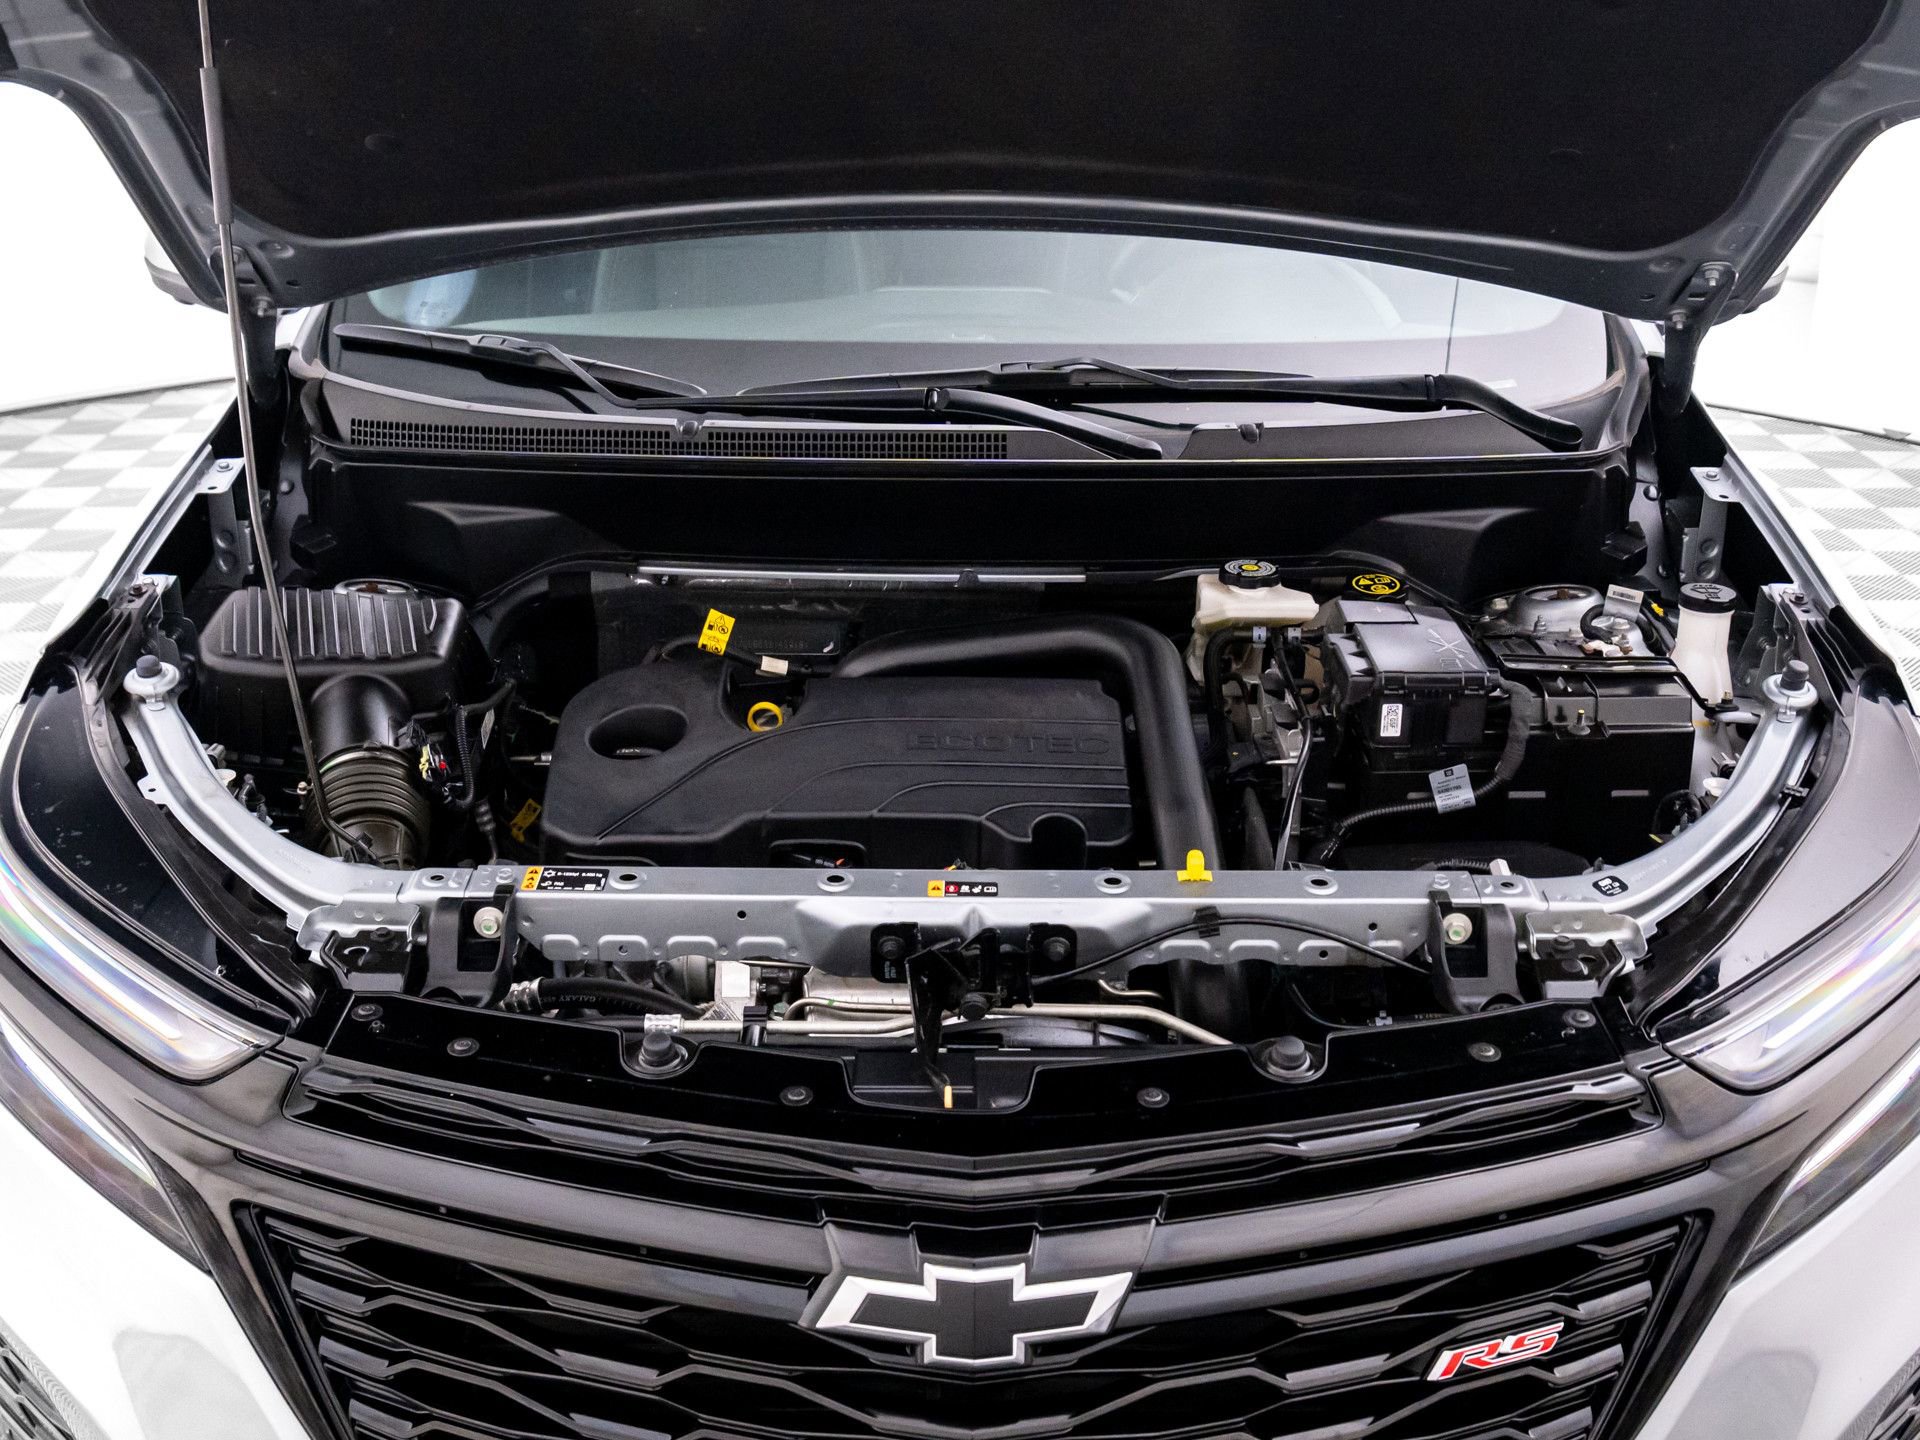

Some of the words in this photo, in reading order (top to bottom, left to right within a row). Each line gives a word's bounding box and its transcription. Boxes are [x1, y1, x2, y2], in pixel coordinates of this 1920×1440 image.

[907, 733, 1111, 755] ECOTEC
[559, 994, 596, 1002] GALAXY
[1427, 1322, 1565, 1381] RS
